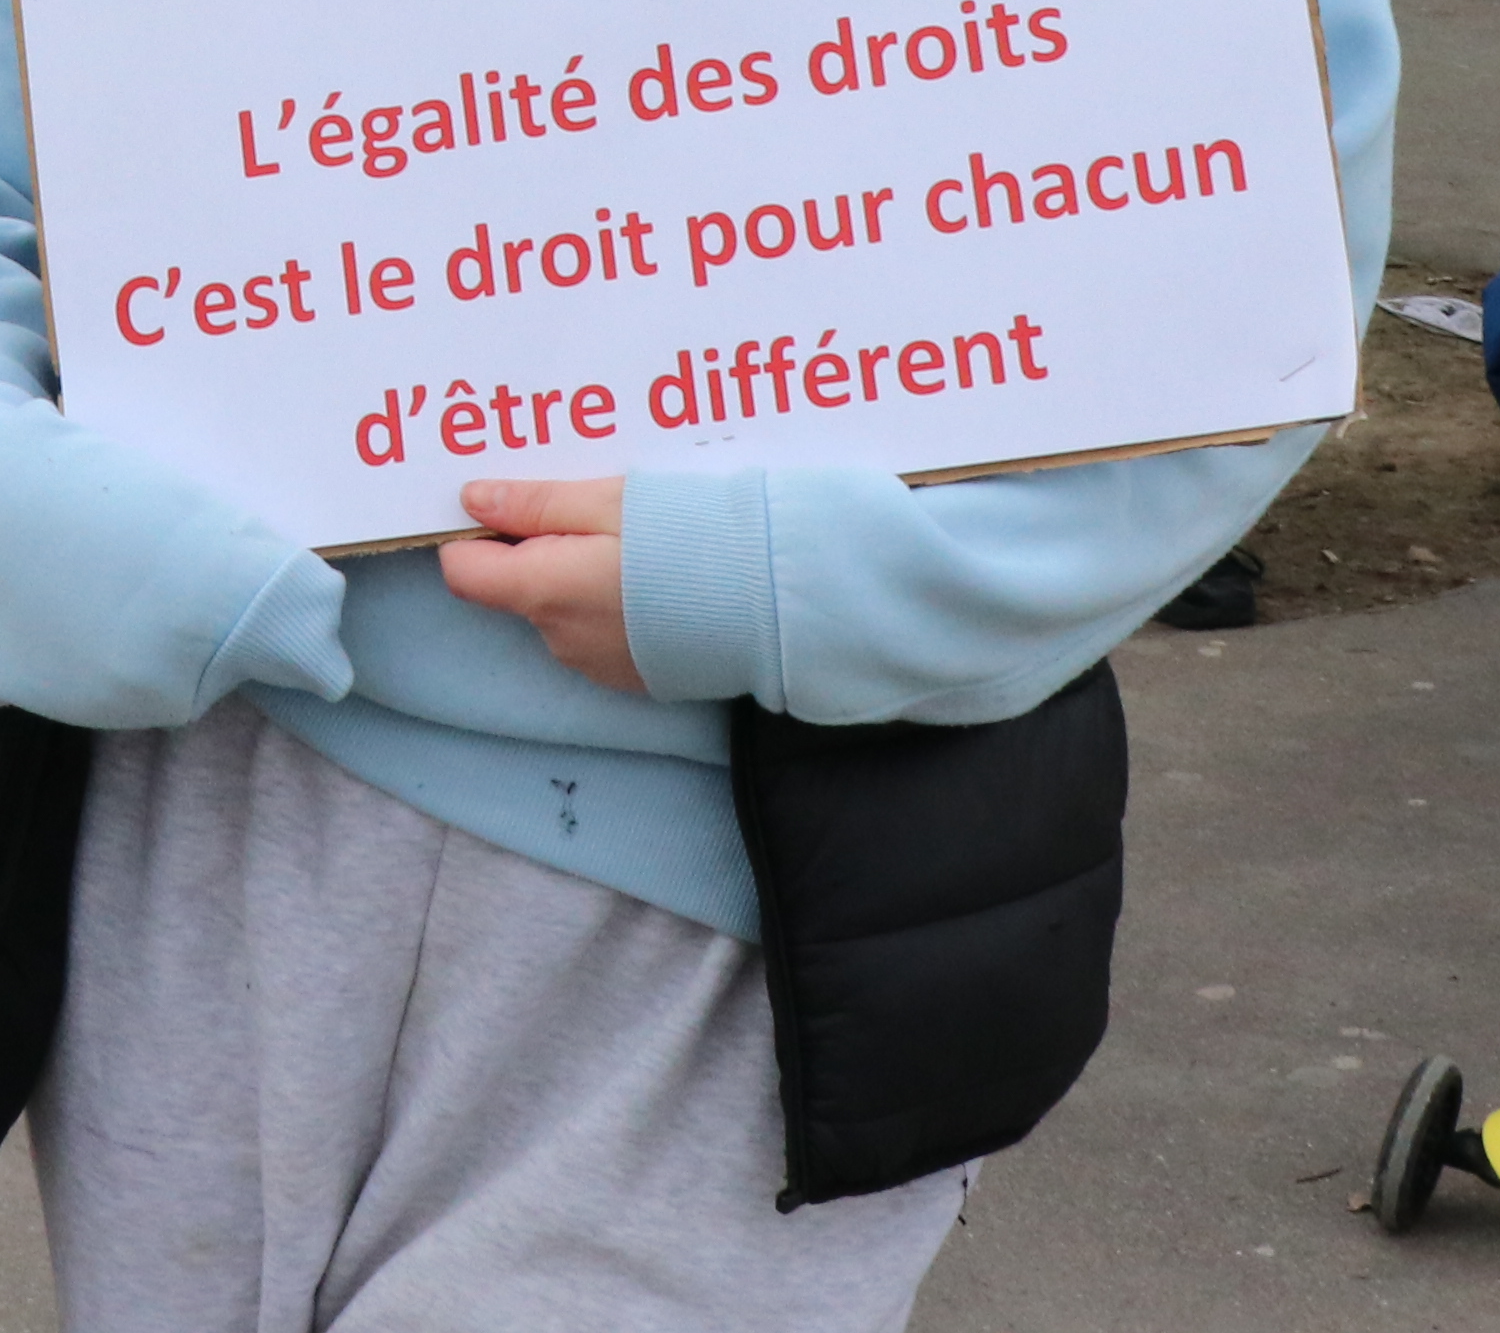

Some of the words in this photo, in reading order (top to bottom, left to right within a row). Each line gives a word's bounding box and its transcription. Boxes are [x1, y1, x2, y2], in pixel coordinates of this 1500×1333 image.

[238, 54, 598, 179] L’égalité
[627, 43, 779, 122] des
[807, 0, 1070, 96] droits
[114, 259, 316, 347] C’est
[340, 241, 415, 316] le
[445, 207, 658, 302] droit
[686, 187, 894, 288] pour
[924, 138, 1249, 235] chacun
[354, 378, 617, 468] d’être
[647, 313, 1049, 430] différent
